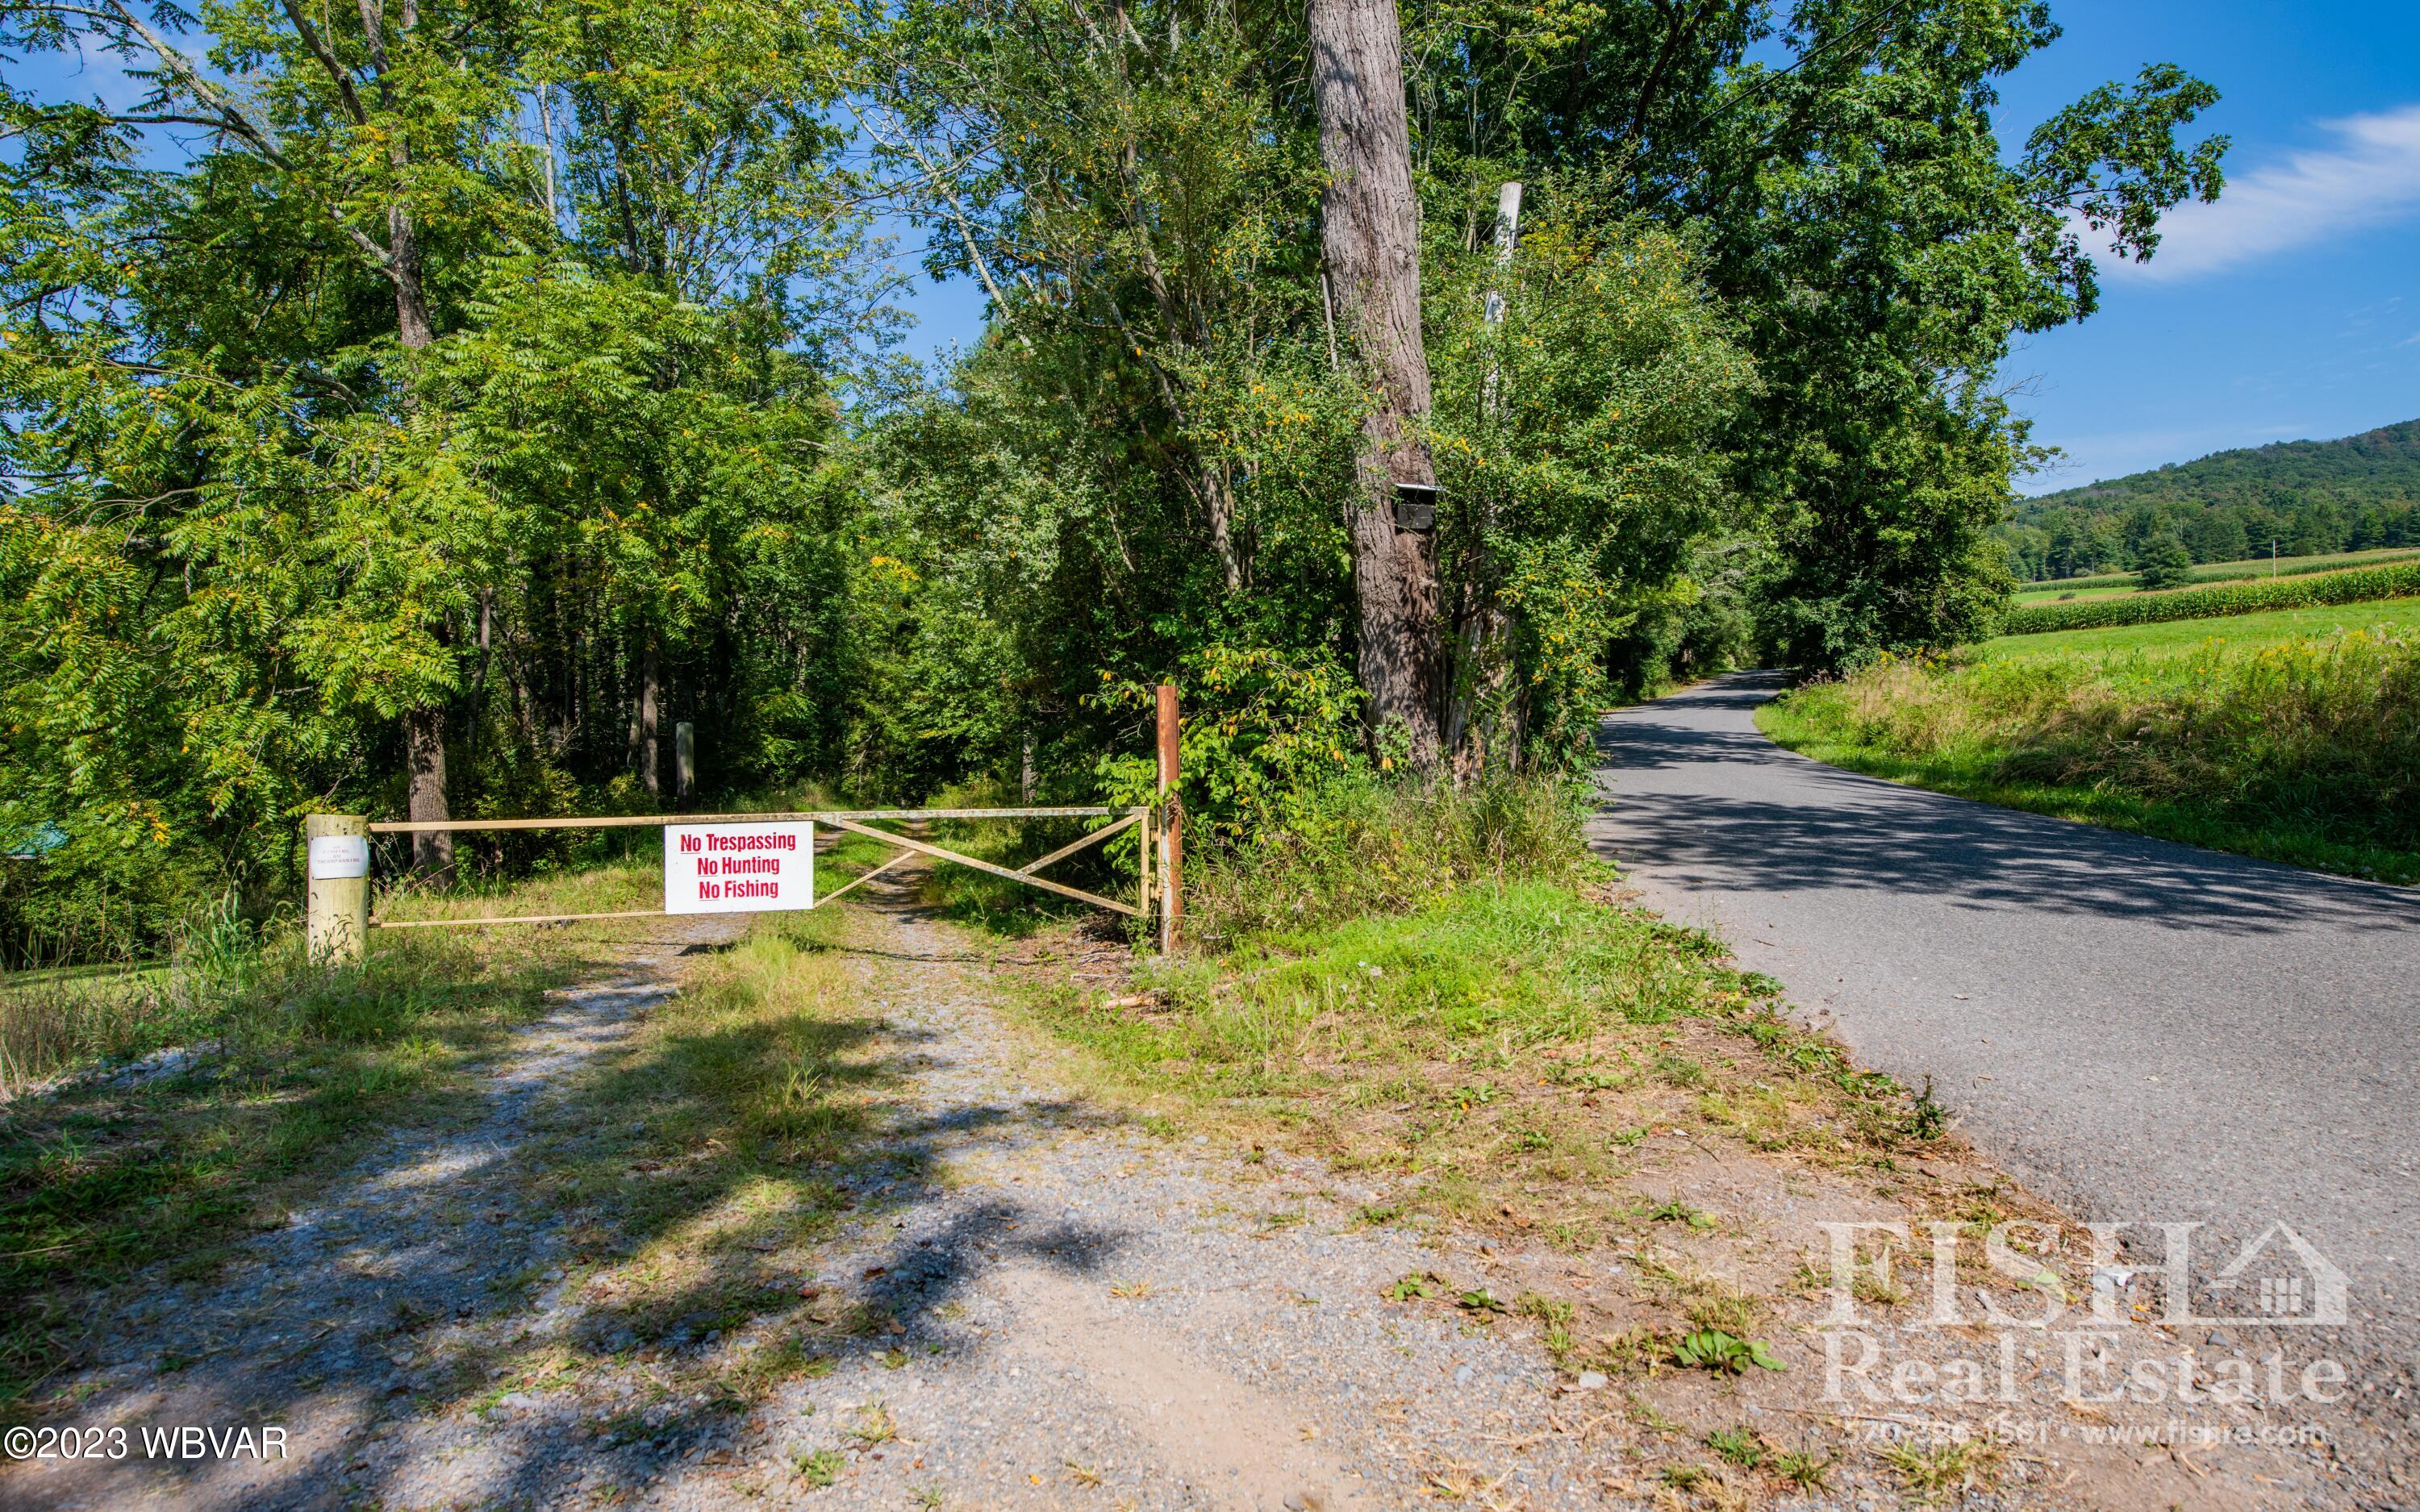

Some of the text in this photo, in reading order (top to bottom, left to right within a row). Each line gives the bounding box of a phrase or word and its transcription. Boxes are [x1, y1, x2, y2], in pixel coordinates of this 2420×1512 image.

[680, 832, 796, 852] No Trespassing
[697, 856, 780, 875] No Hunting
[699, 880, 778, 899] No Fishing
